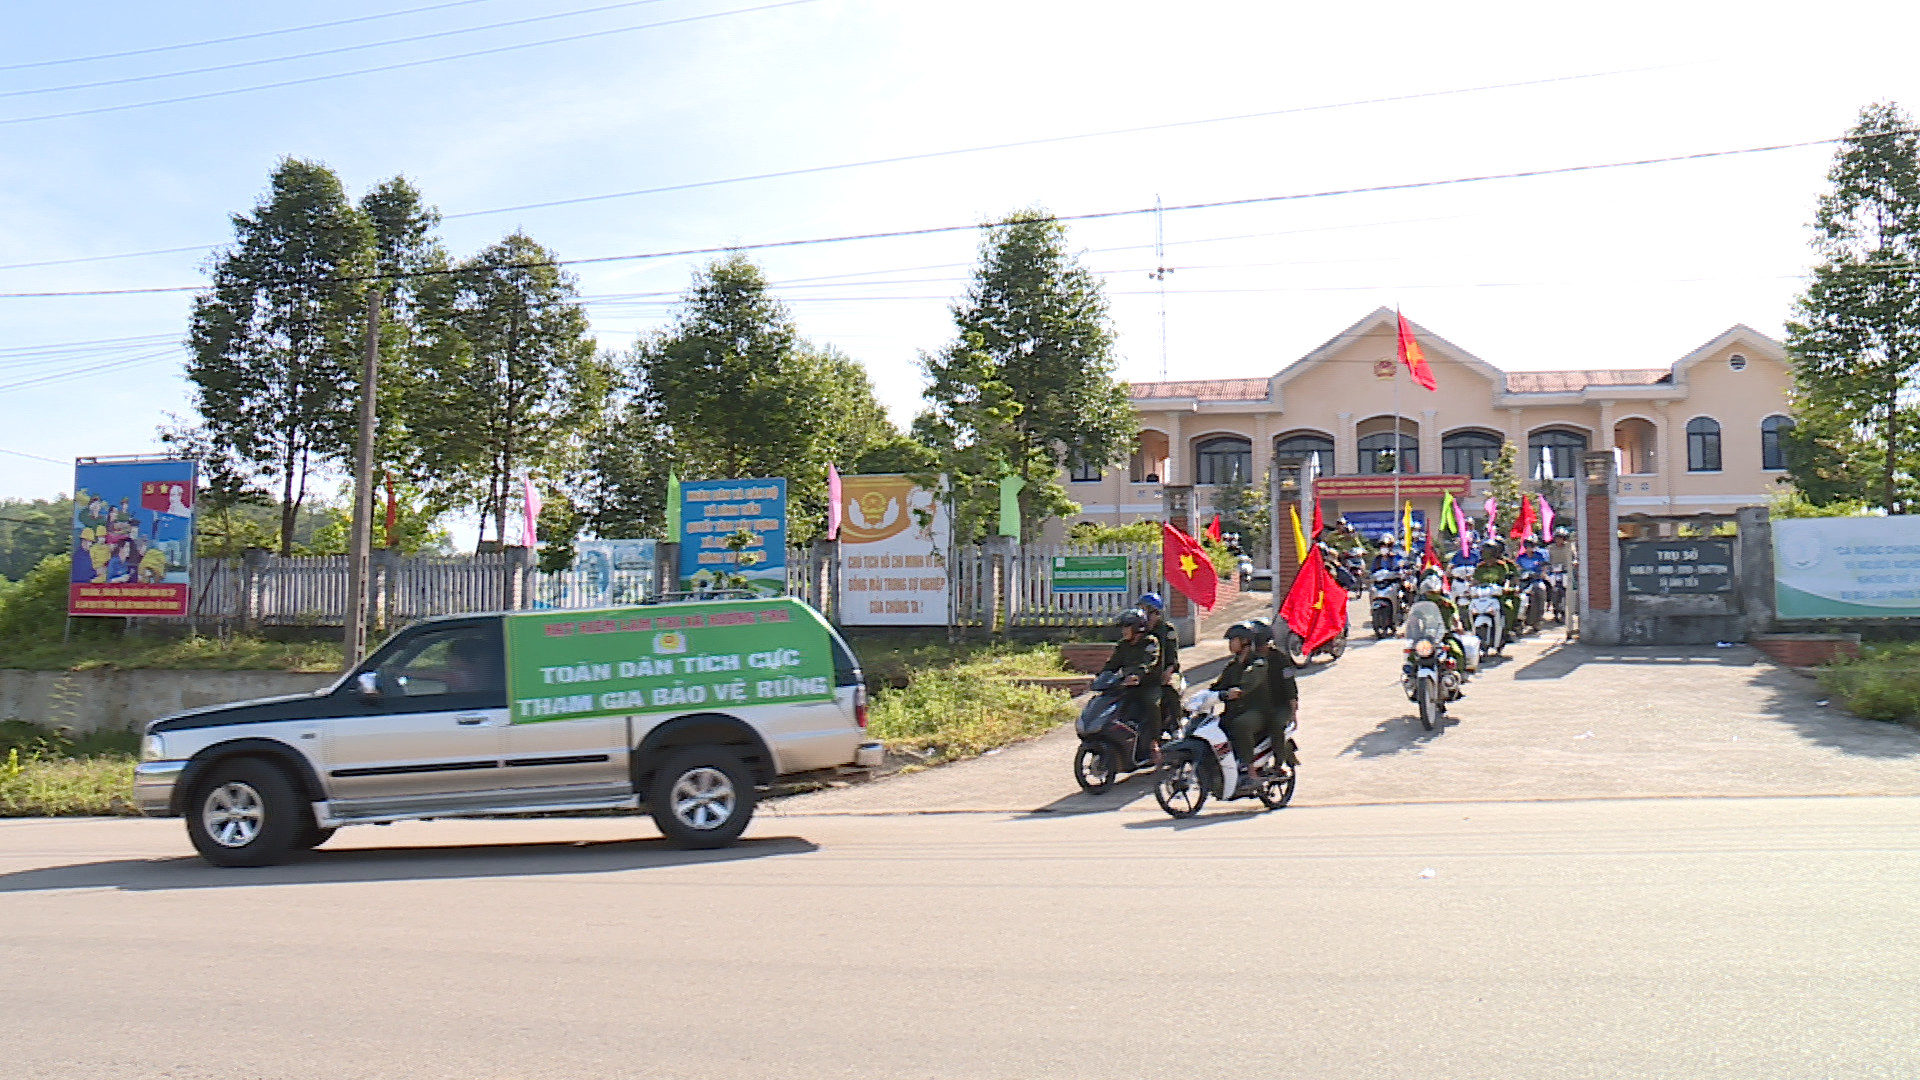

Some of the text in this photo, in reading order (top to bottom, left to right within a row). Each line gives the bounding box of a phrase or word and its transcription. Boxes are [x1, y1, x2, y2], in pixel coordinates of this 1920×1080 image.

[1656, 550, 1680, 562] TRỤ
[540, 647, 801, 685] TOÀN DÂN TÍCH CỰC
[517, 674, 829, 718] THAM GIA BẢO VỆ RỪNG
